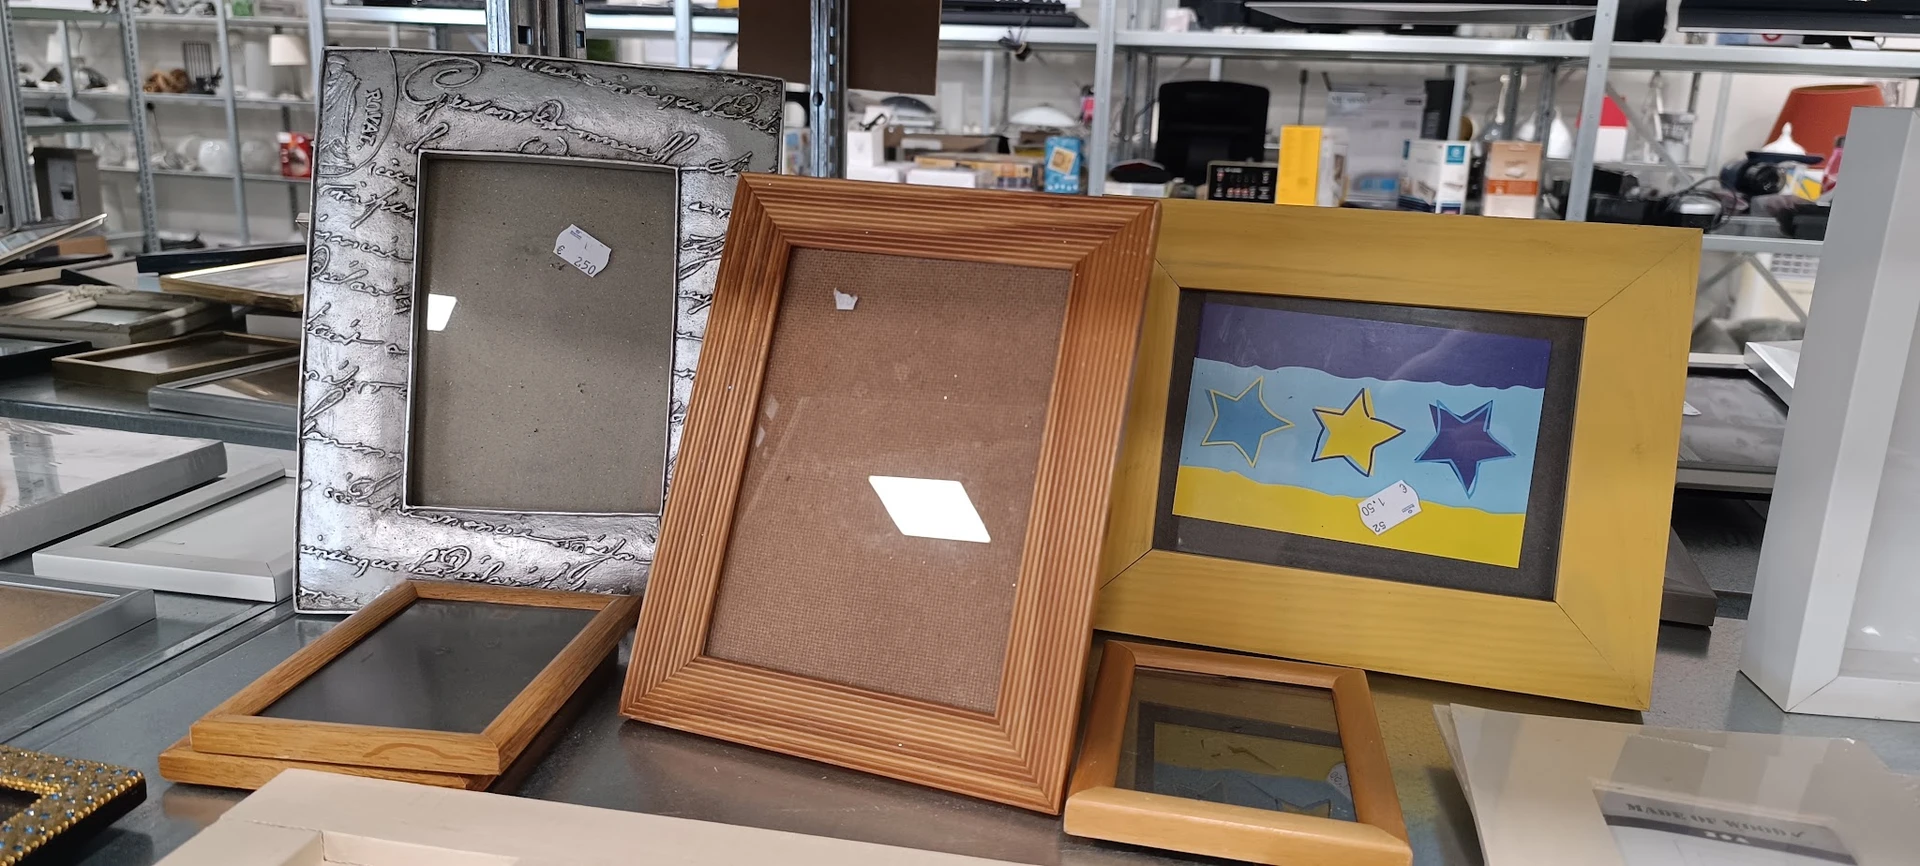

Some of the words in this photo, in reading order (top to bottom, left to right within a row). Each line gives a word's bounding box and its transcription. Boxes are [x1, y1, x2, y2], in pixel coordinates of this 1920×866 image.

[1372, 521, 1387, 533] 52
[1626, 803, 1687, 820] MADE
[1690, 814, 1717, 825] OF
[1722, 819, 1787, 836] WOOD
